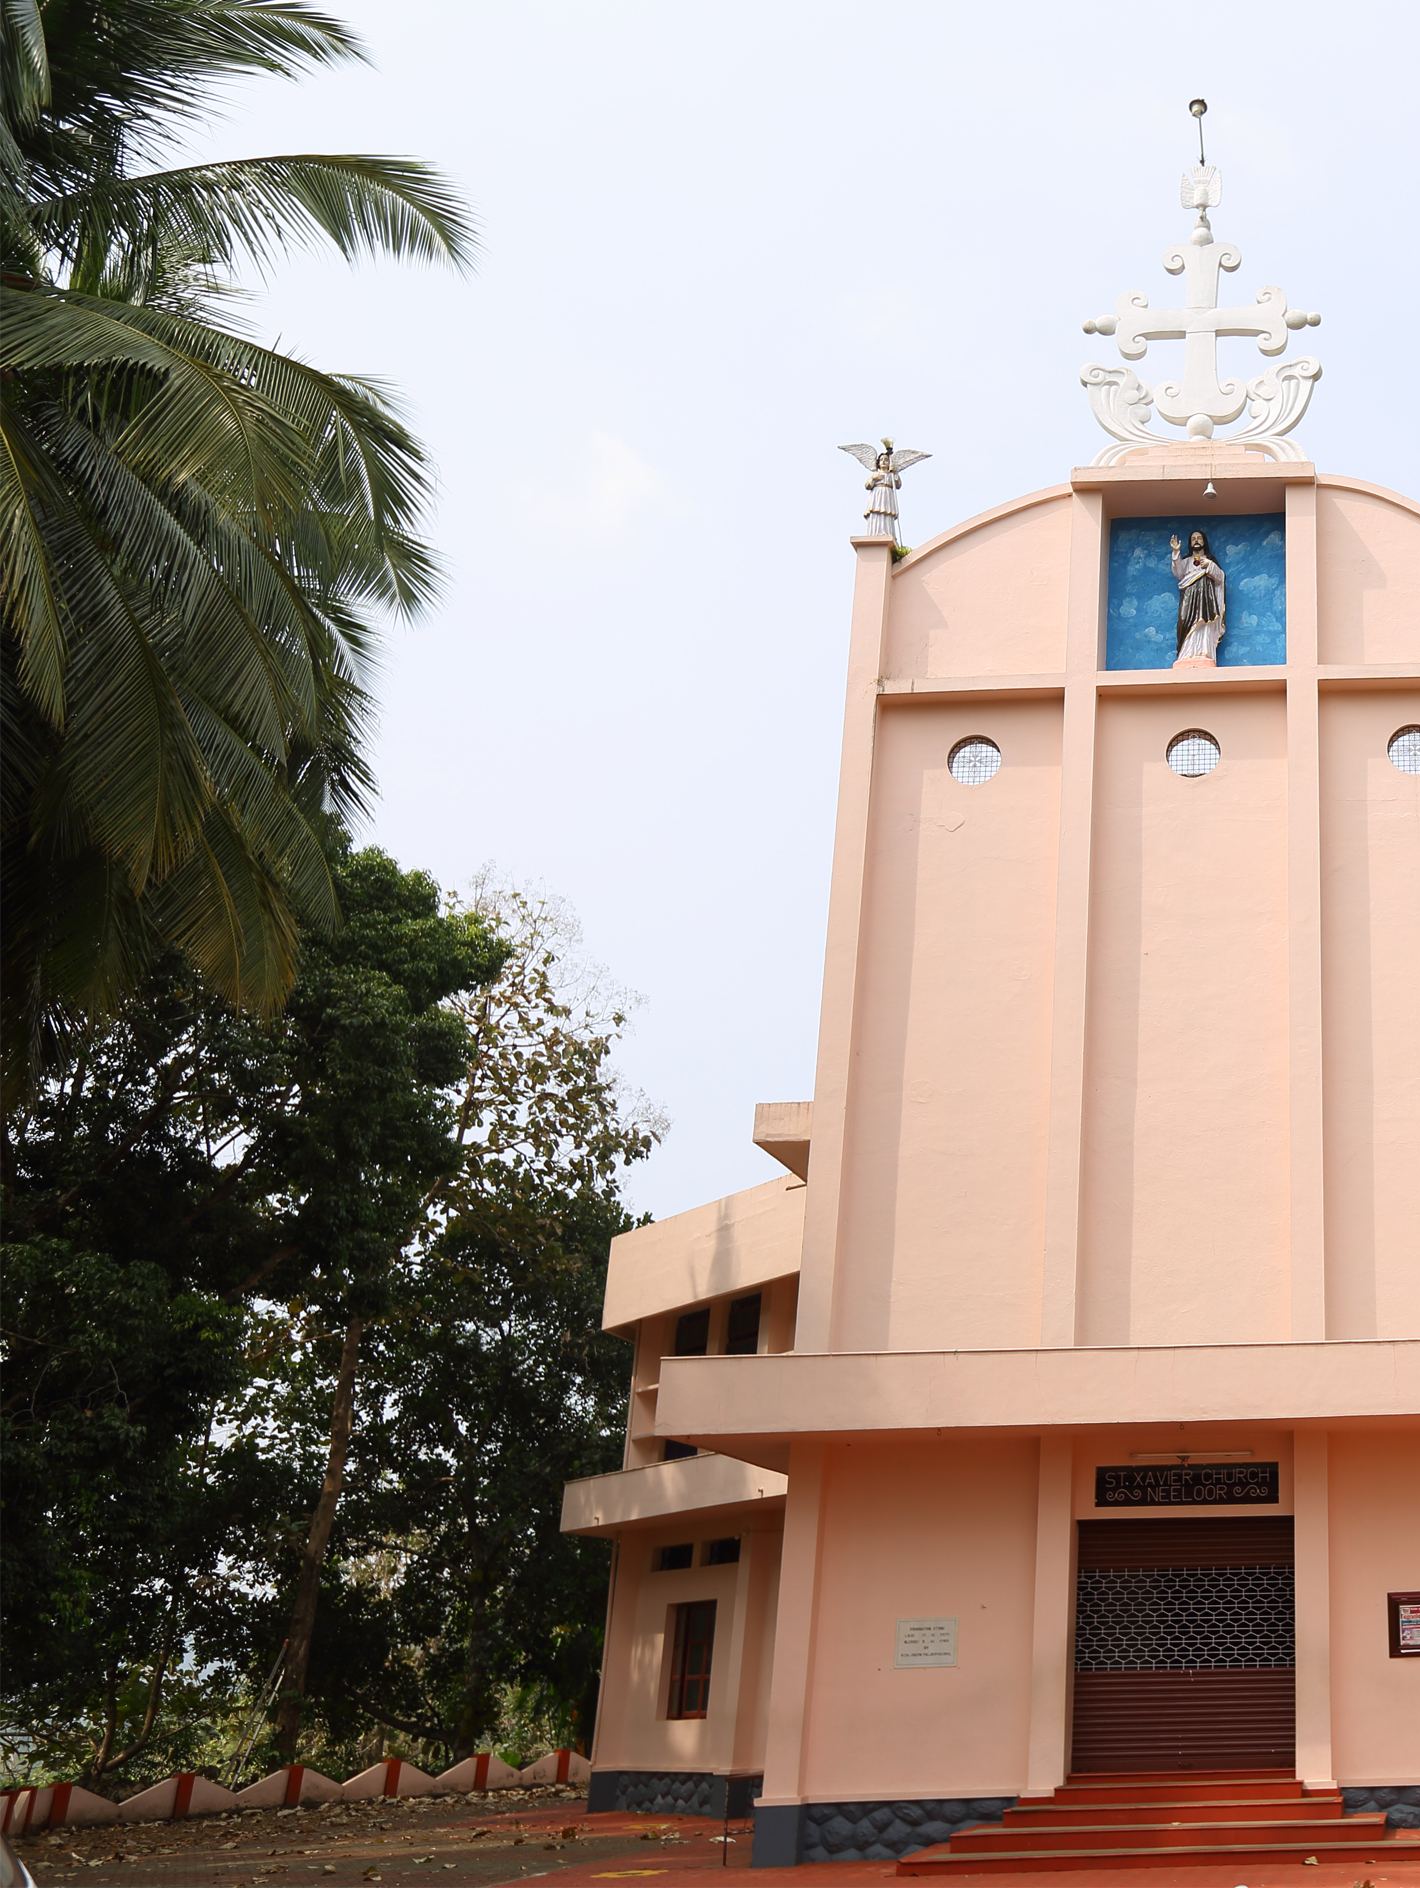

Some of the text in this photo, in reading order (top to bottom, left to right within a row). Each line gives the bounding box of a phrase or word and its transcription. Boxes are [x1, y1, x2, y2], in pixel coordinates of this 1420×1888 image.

[1105, 1468, 1270, 1487] ST. XAVIER CHURCH
[1147, 1485, 1228, 1502] NEELOOR
